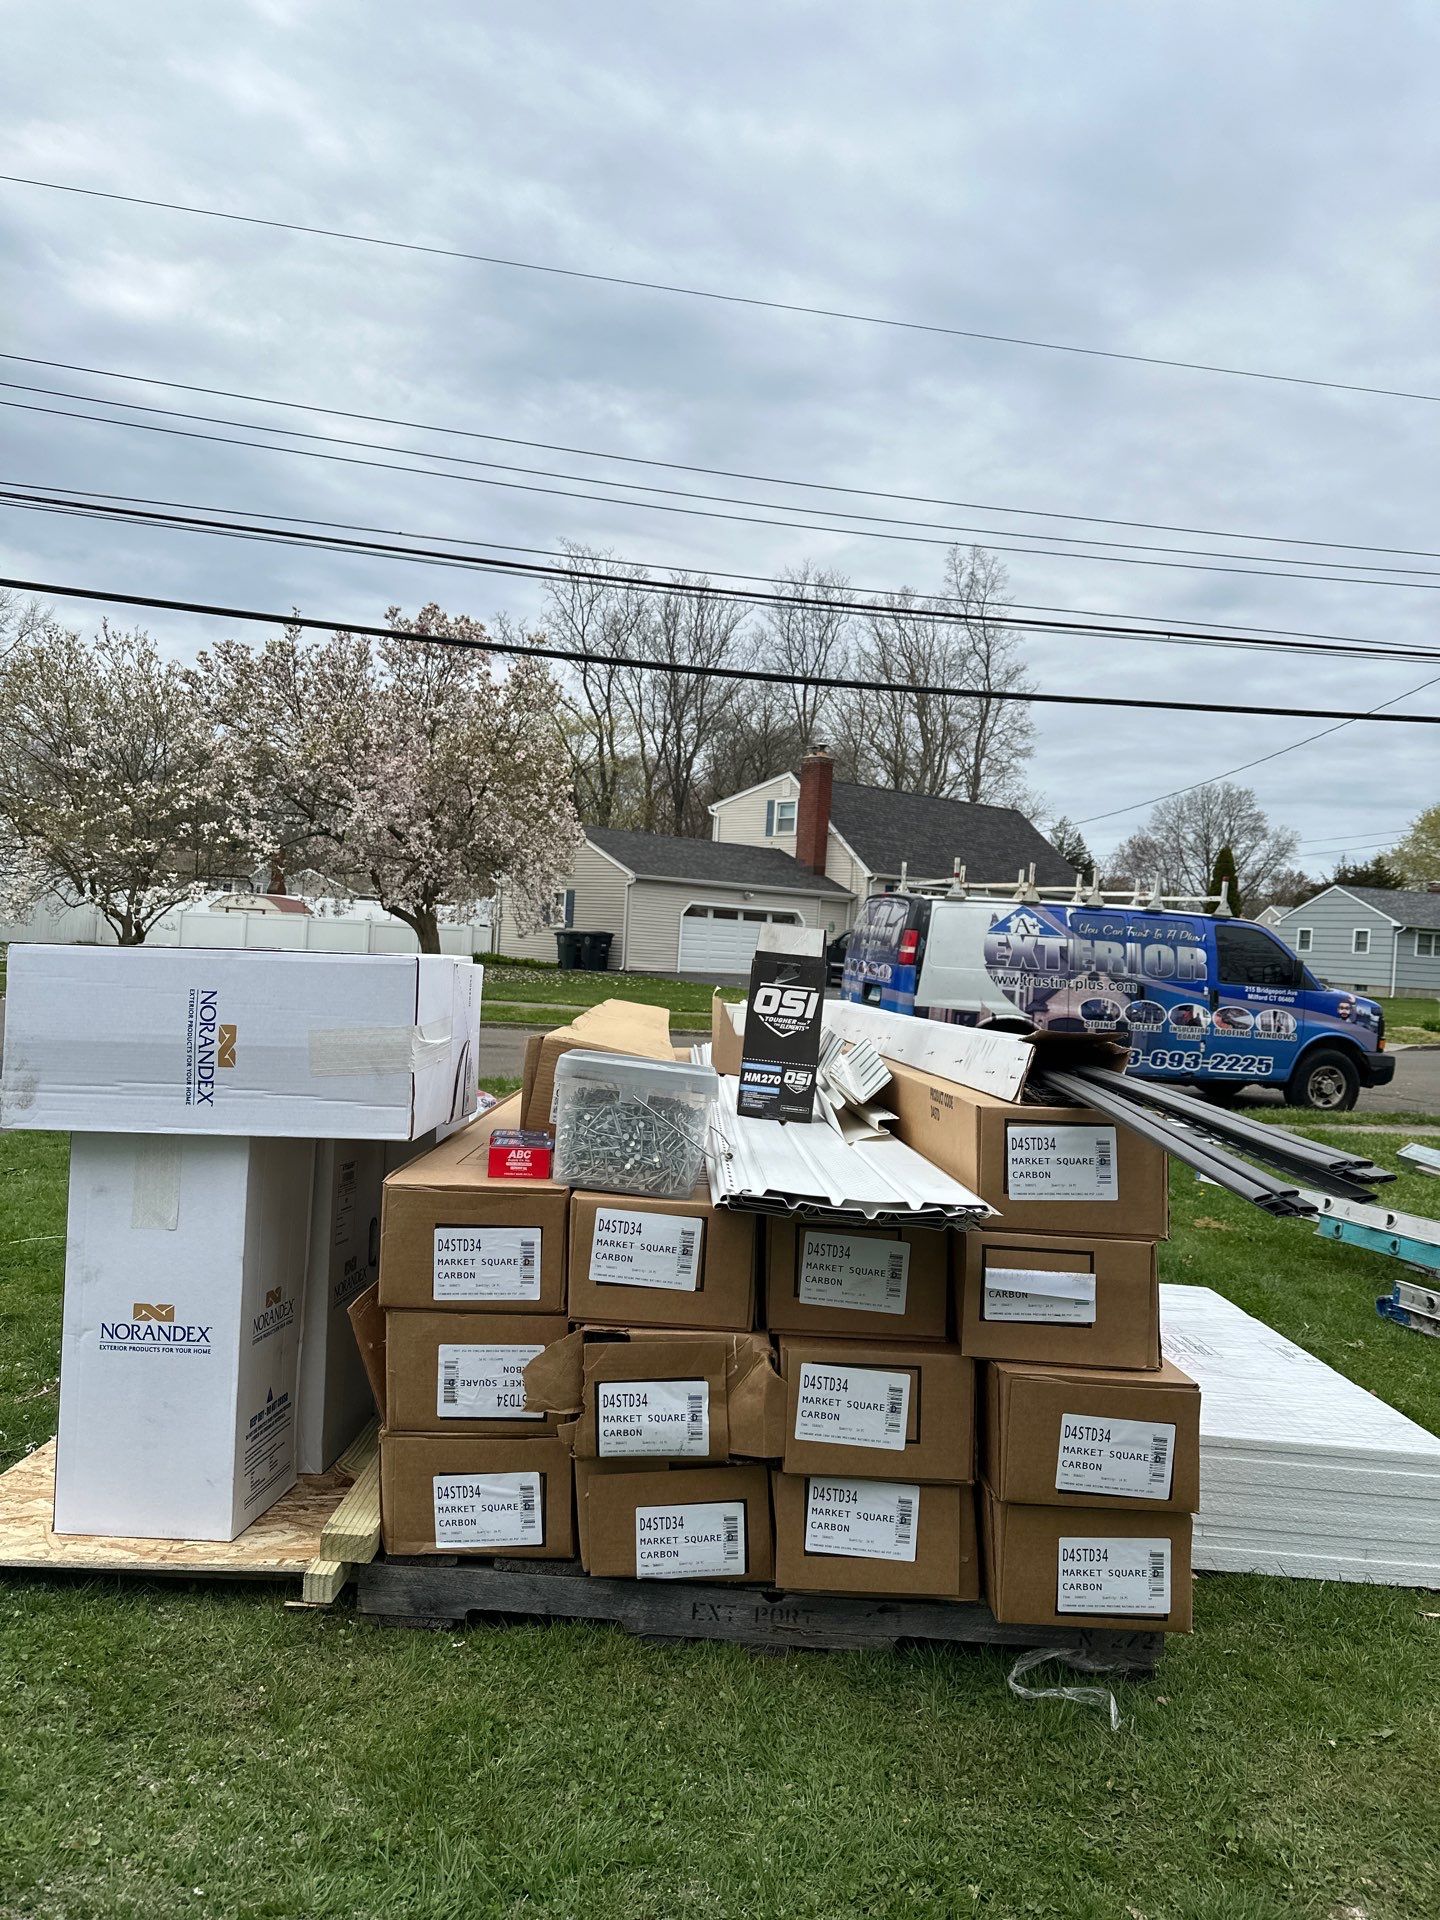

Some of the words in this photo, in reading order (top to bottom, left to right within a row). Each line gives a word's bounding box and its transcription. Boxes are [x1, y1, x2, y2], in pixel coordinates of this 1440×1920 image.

[986, 935, 1207, 980] EXTERIOR
[753, 988, 819, 1018] OSI
[765, 1016, 797, 1024] TOUGHER
[1085, 1021, 1116, 1029] SIDING
[1214, 1029, 1250, 1037] ROOFING
[1255, 1032, 1297, 1041] WINDOWS
[197, 990, 217, 1107] NORANDEX
[744, 1072, 781, 1084] HM270
[784, 1072, 813, 1085] OSI
[1012, 1137, 1056, 1151] D4STD34
[508, 1150, 532, 1159] ABC
[1012, 1157, 1050, 1165] MARKET
[1056, 1157, 1094, 1165] SQUARE
[598, 1219, 642, 1236] D4STD34
[438, 1239, 481, 1251] D4STD34
[597, 1239, 635, 1249] MARKET
[640, 1243, 677, 1254] SQUARE
[807, 1242, 850, 1259] D4STD34
[595, 1252, 633, 1262] CARBON
[806, 1262, 844, 1272] MARKET
[849, 1267, 886, 1277] SQUARE
[805, 1276, 842, 1286] CARBON
[253, 1299, 295, 1335] NORANDEX
[100, 1322, 211, 1343] NORANDEX
[100, 1344, 127, 1352] EXTERIOR
[804, 1375, 848, 1392] D4STD34
[603, 1393, 648, 1408] D4STD34
[802, 1396, 841, 1406] MARKET
[847, 1400, 885, 1411] SQUARE
[603, 1415, 642, 1423] MARKET
[648, 1414, 686, 1422] SQUARE
[801, 1410, 839, 1420] CARBON
[603, 1429, 642, 1437] CARBON
[1065, 1425, 1111, 1442] D4STD34
[1062, 1446, 1103, 1457] MARKET
[1110, 1451, 1149, 1461] SQUARE
[1062, 1460, 1102, 1471] CARBON
[437, 1485, 481, 1499] D4STD34
[813, 1486, 857, 1504] D4STD34
[438, 1505, 475, 1513] MARKET
[481, 1503, 518, 1512] SQUARE
[811, 1507, 851, 1518] MARKET
[856, 1512, 894, 1523] SQUARE
[439, 1519, 476, 1527] CARBON
[640, 1516, 684, 1530] D4STD34
[811, 1522, 850, 1532] CARBON
[640, 1537, 678, 1545] MARKET
[684, 1534, 721, 1543] SQUARE
[641, 1550, 679, 1559] CARBON
[1062, 1548, 1108, 1562] D4STD34
[1062, 1569, 1102, 1577] MARKET
[1108, 1569, 1147, 1578] SQUARE
[1062, 1583, 1102, 1591] CARBON
